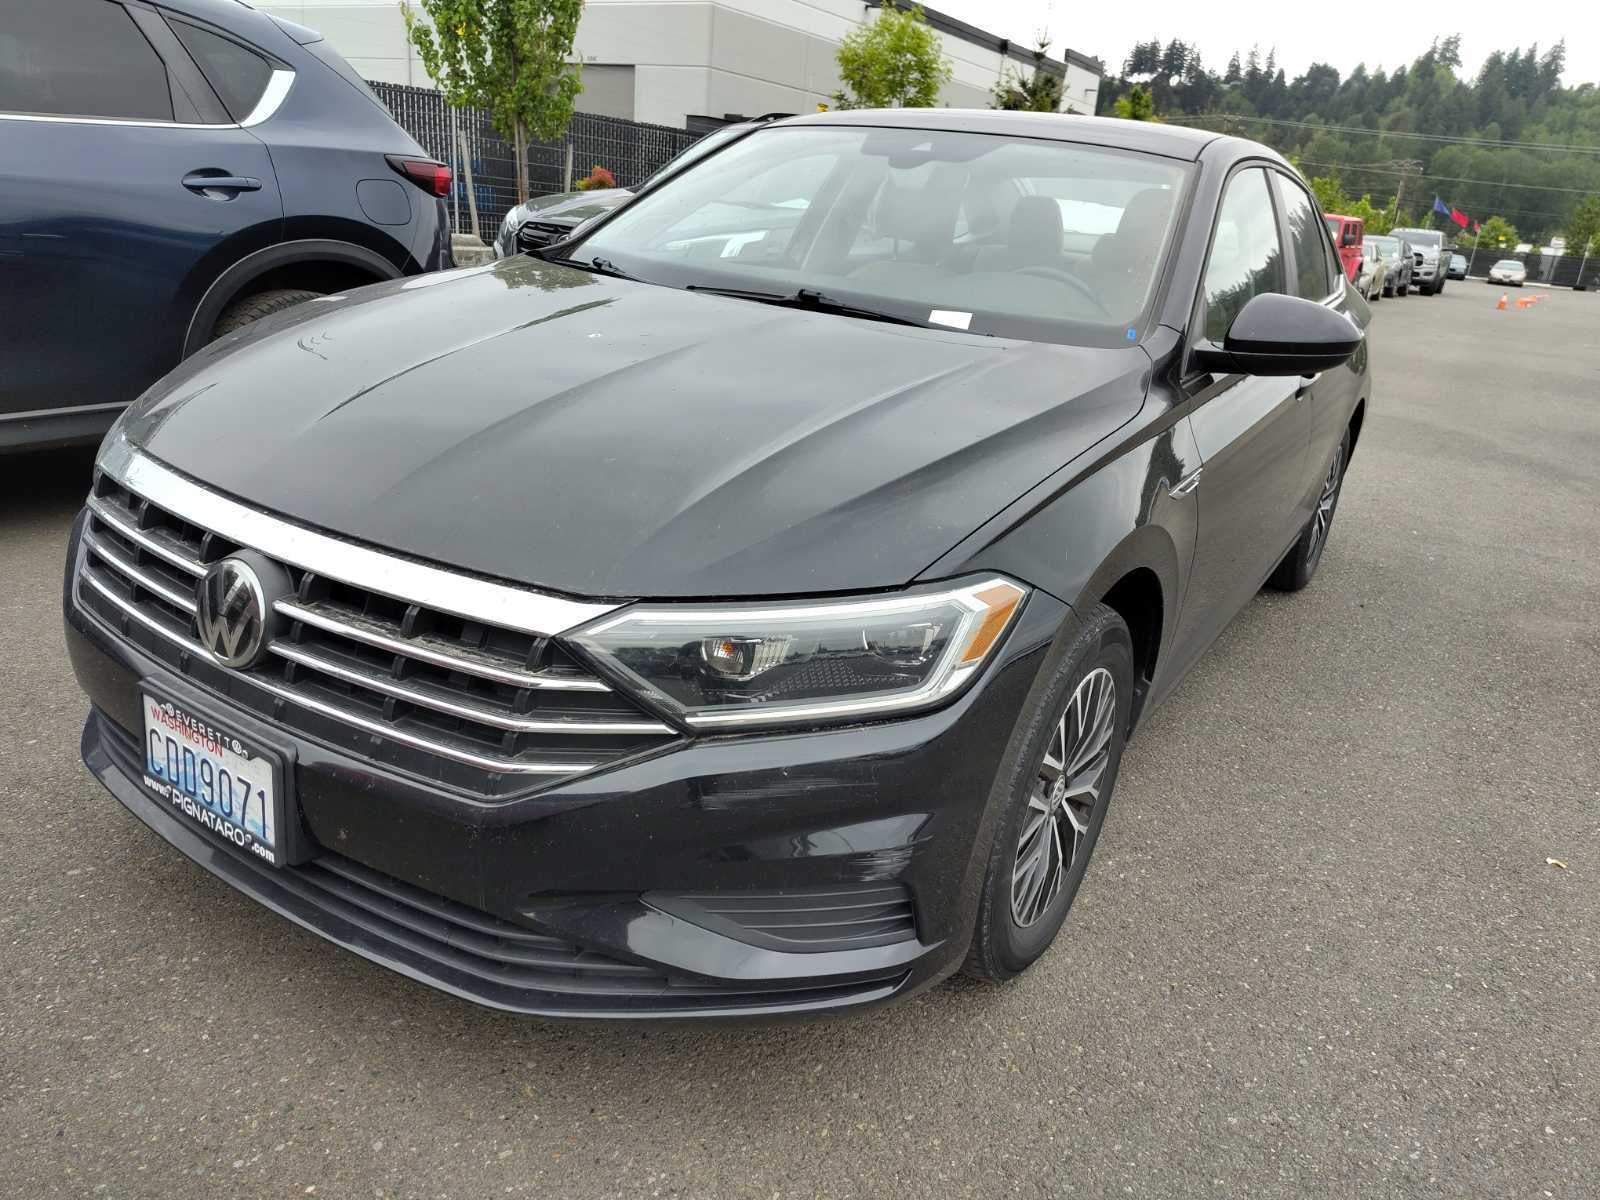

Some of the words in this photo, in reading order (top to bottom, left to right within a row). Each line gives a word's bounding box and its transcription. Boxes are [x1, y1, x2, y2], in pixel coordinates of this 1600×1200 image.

[151, 705, 224, 758] WASHINGTON
[175, 710, 230, 748] EVERETT
[150, 728, 266, 839] CDD9071
[172, 789, 245, 846] PIGNATARO
